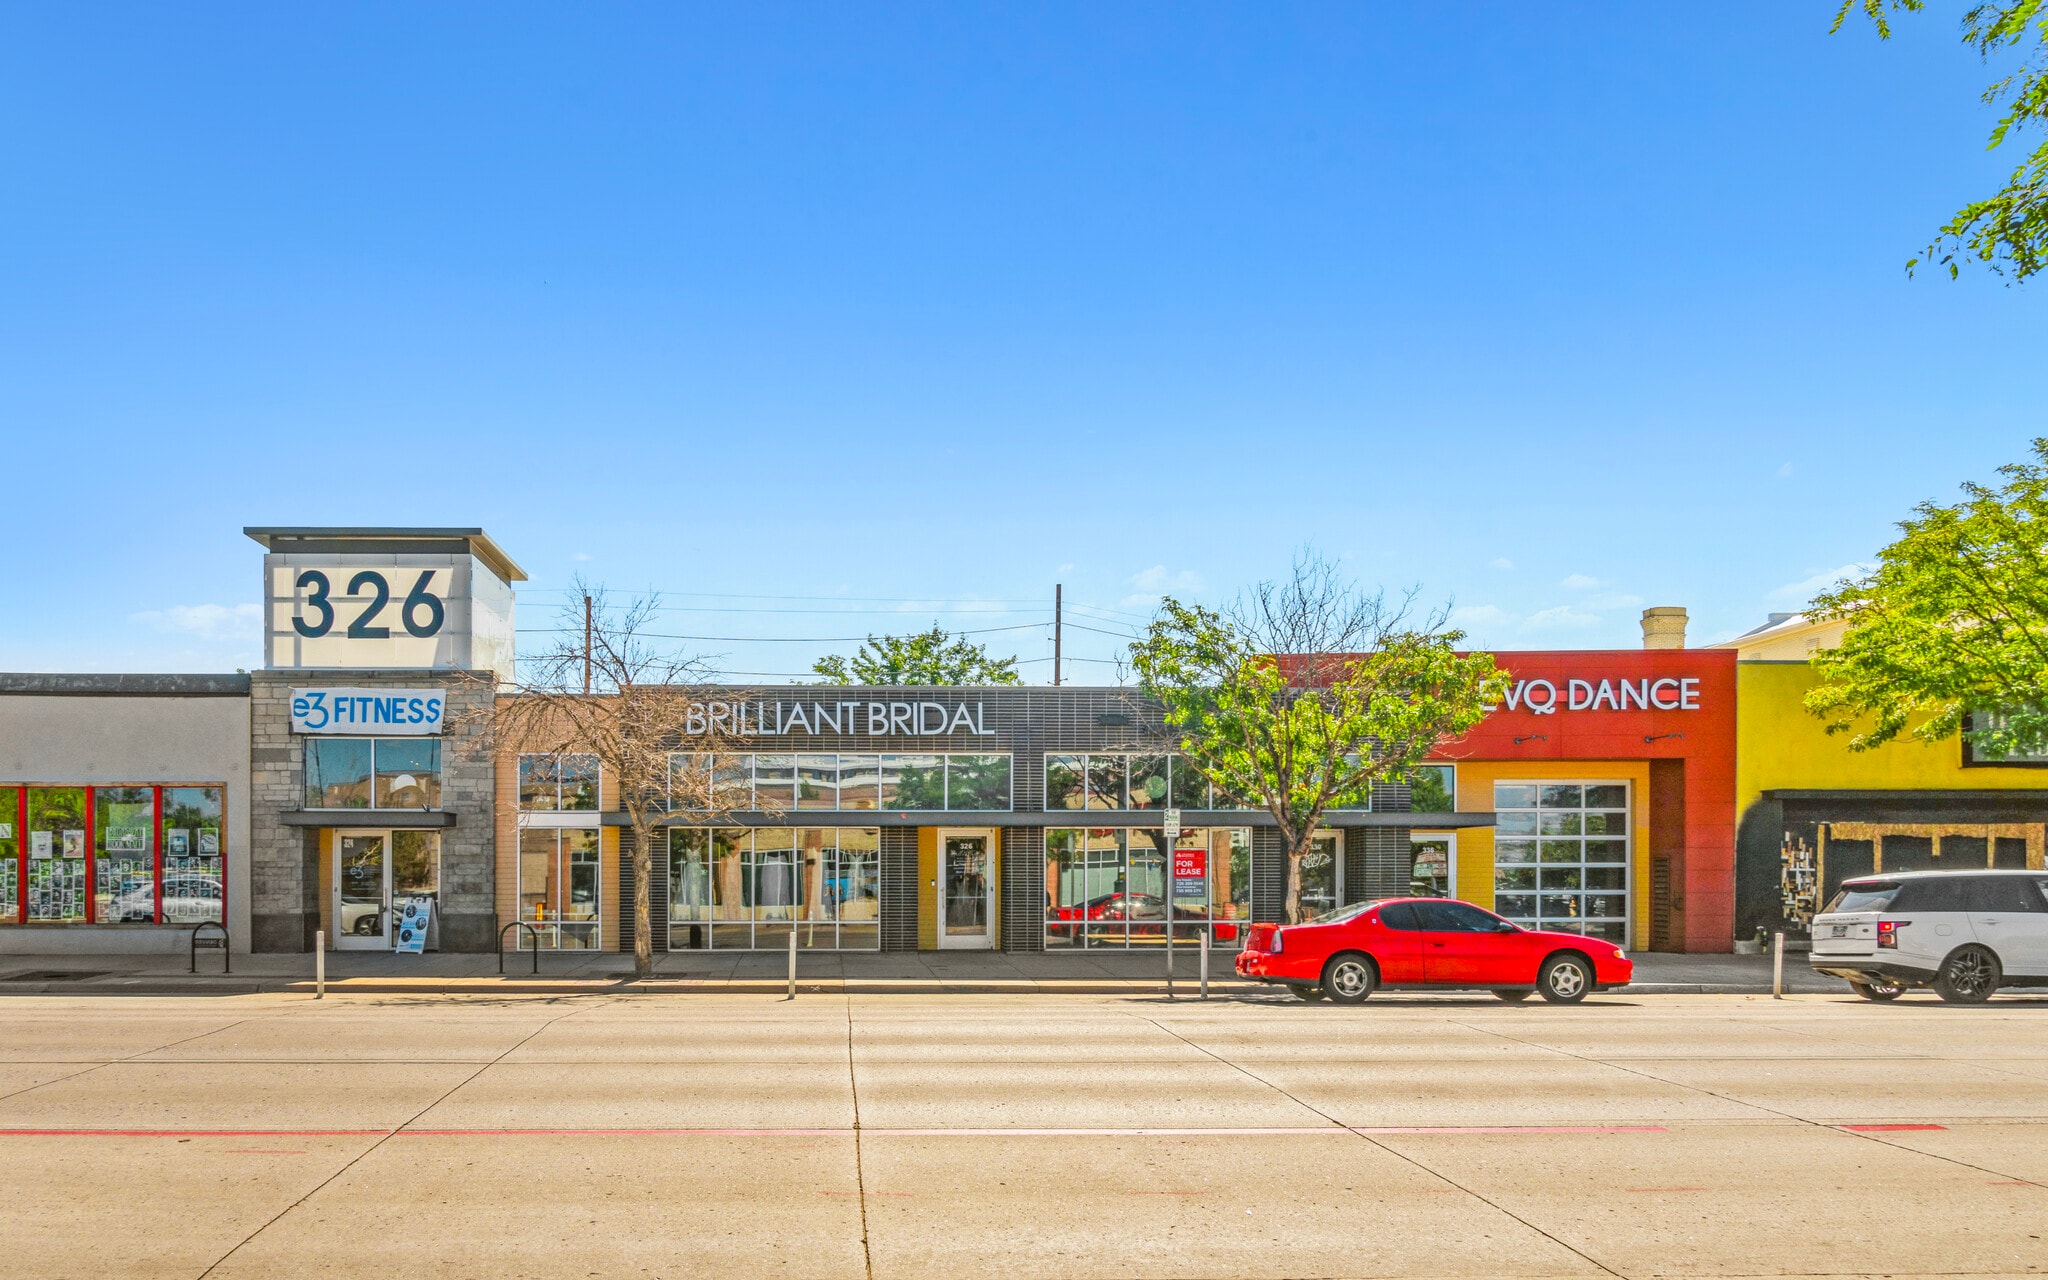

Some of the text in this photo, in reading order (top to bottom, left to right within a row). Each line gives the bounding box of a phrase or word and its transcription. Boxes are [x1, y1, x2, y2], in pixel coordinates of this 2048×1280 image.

[292, 570, 444, 638] 326
[293, 692, 441, 729] e3 FITNESS
[1568, 678, 1700, 711] DANCE
[686, 701, 996, 736] BRILLIANT BRIDAL
[960, 842, 973, 850] 326
[1175, 860, 1193, 868] FOR
[1175, 868, 1202, 876] LEASE
